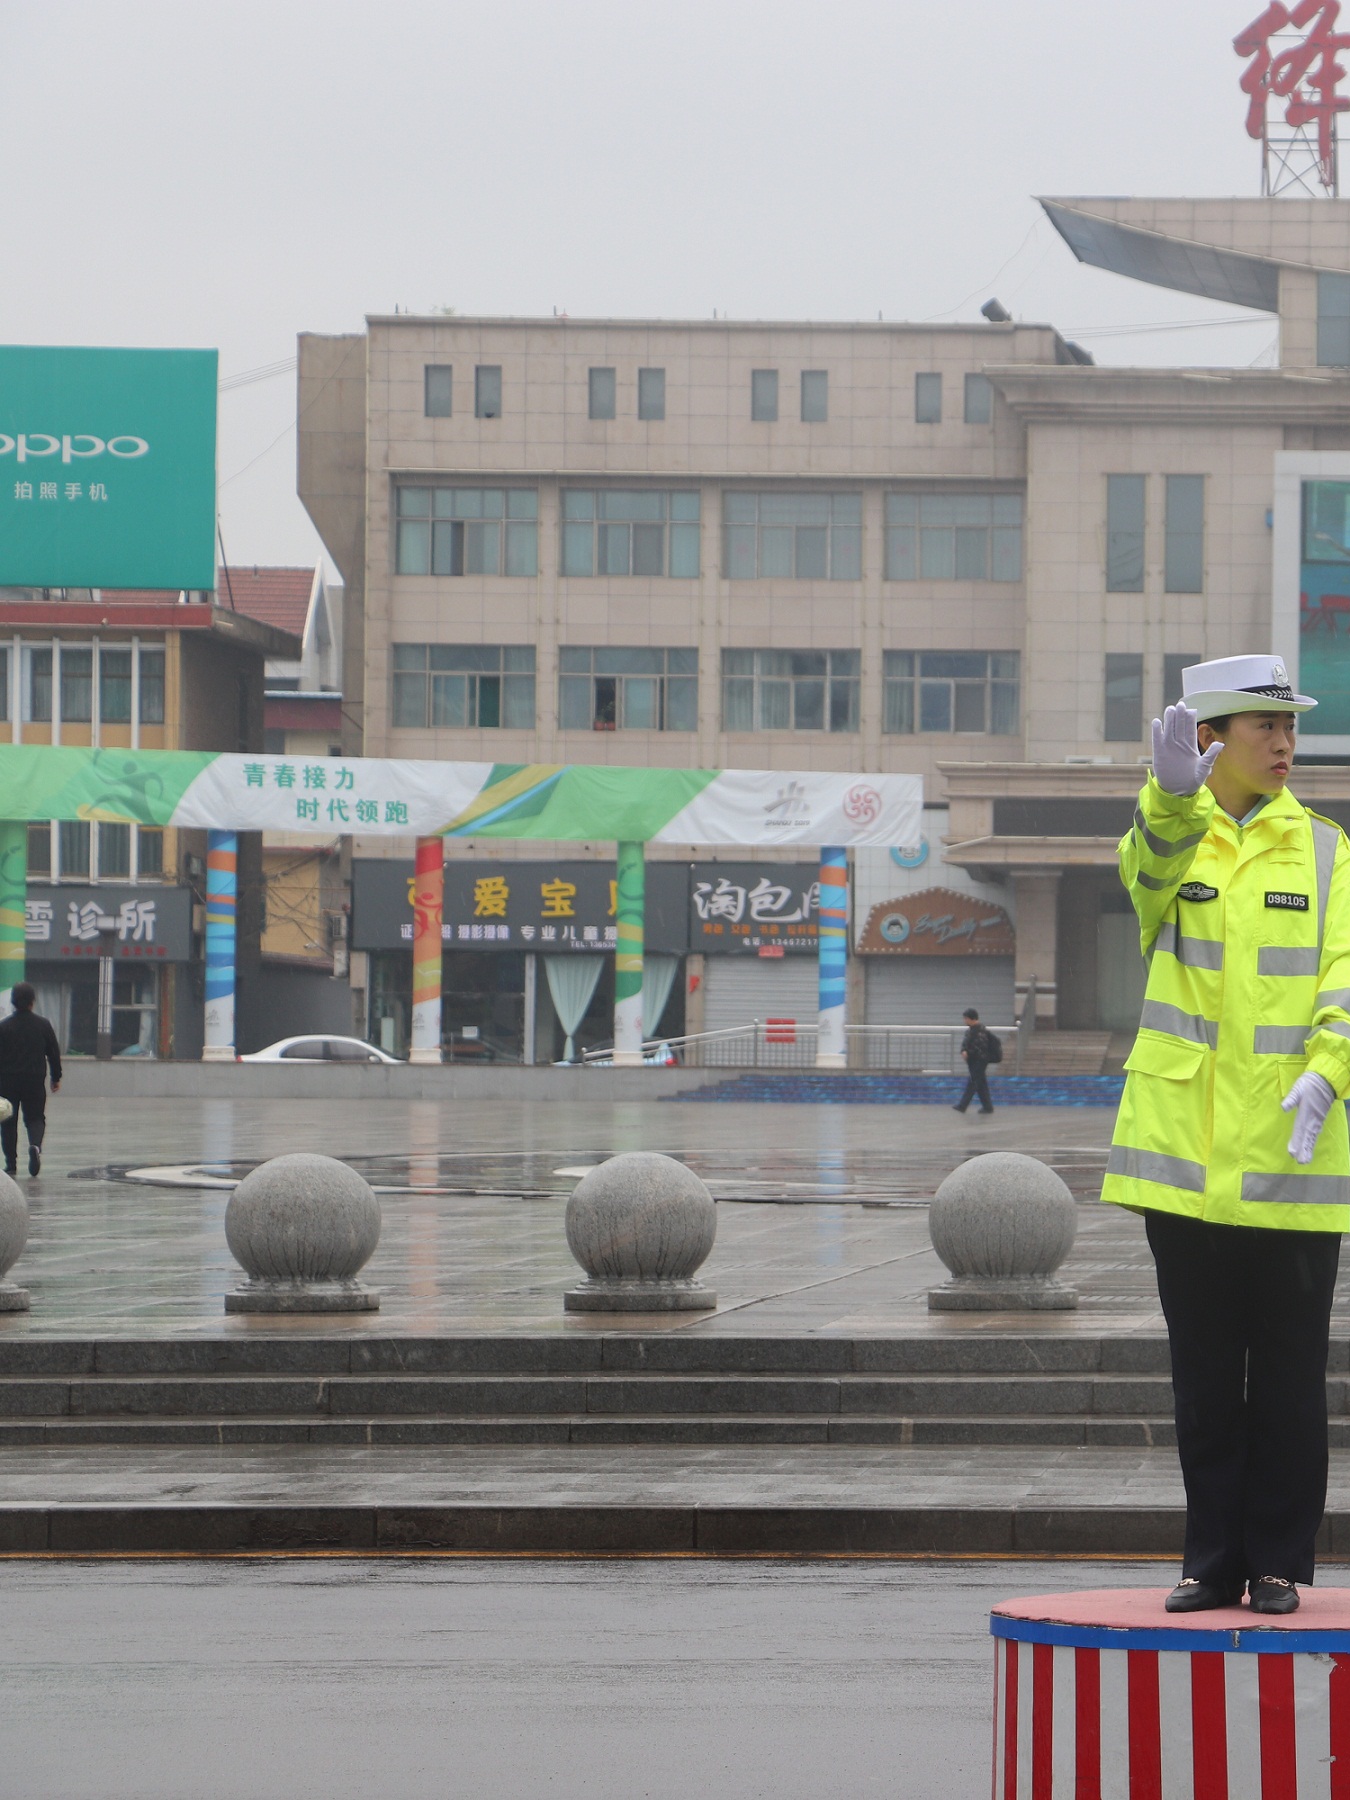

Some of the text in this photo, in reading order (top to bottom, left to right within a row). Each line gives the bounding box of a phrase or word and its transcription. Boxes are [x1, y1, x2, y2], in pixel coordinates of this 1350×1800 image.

[14, 481, 108, 502] 拍照手机
[243, 763, 355, 790] 青春接力
[296, 797, 408, 824] 时代领跑
[1267, 894, 1306, 907] 098105
